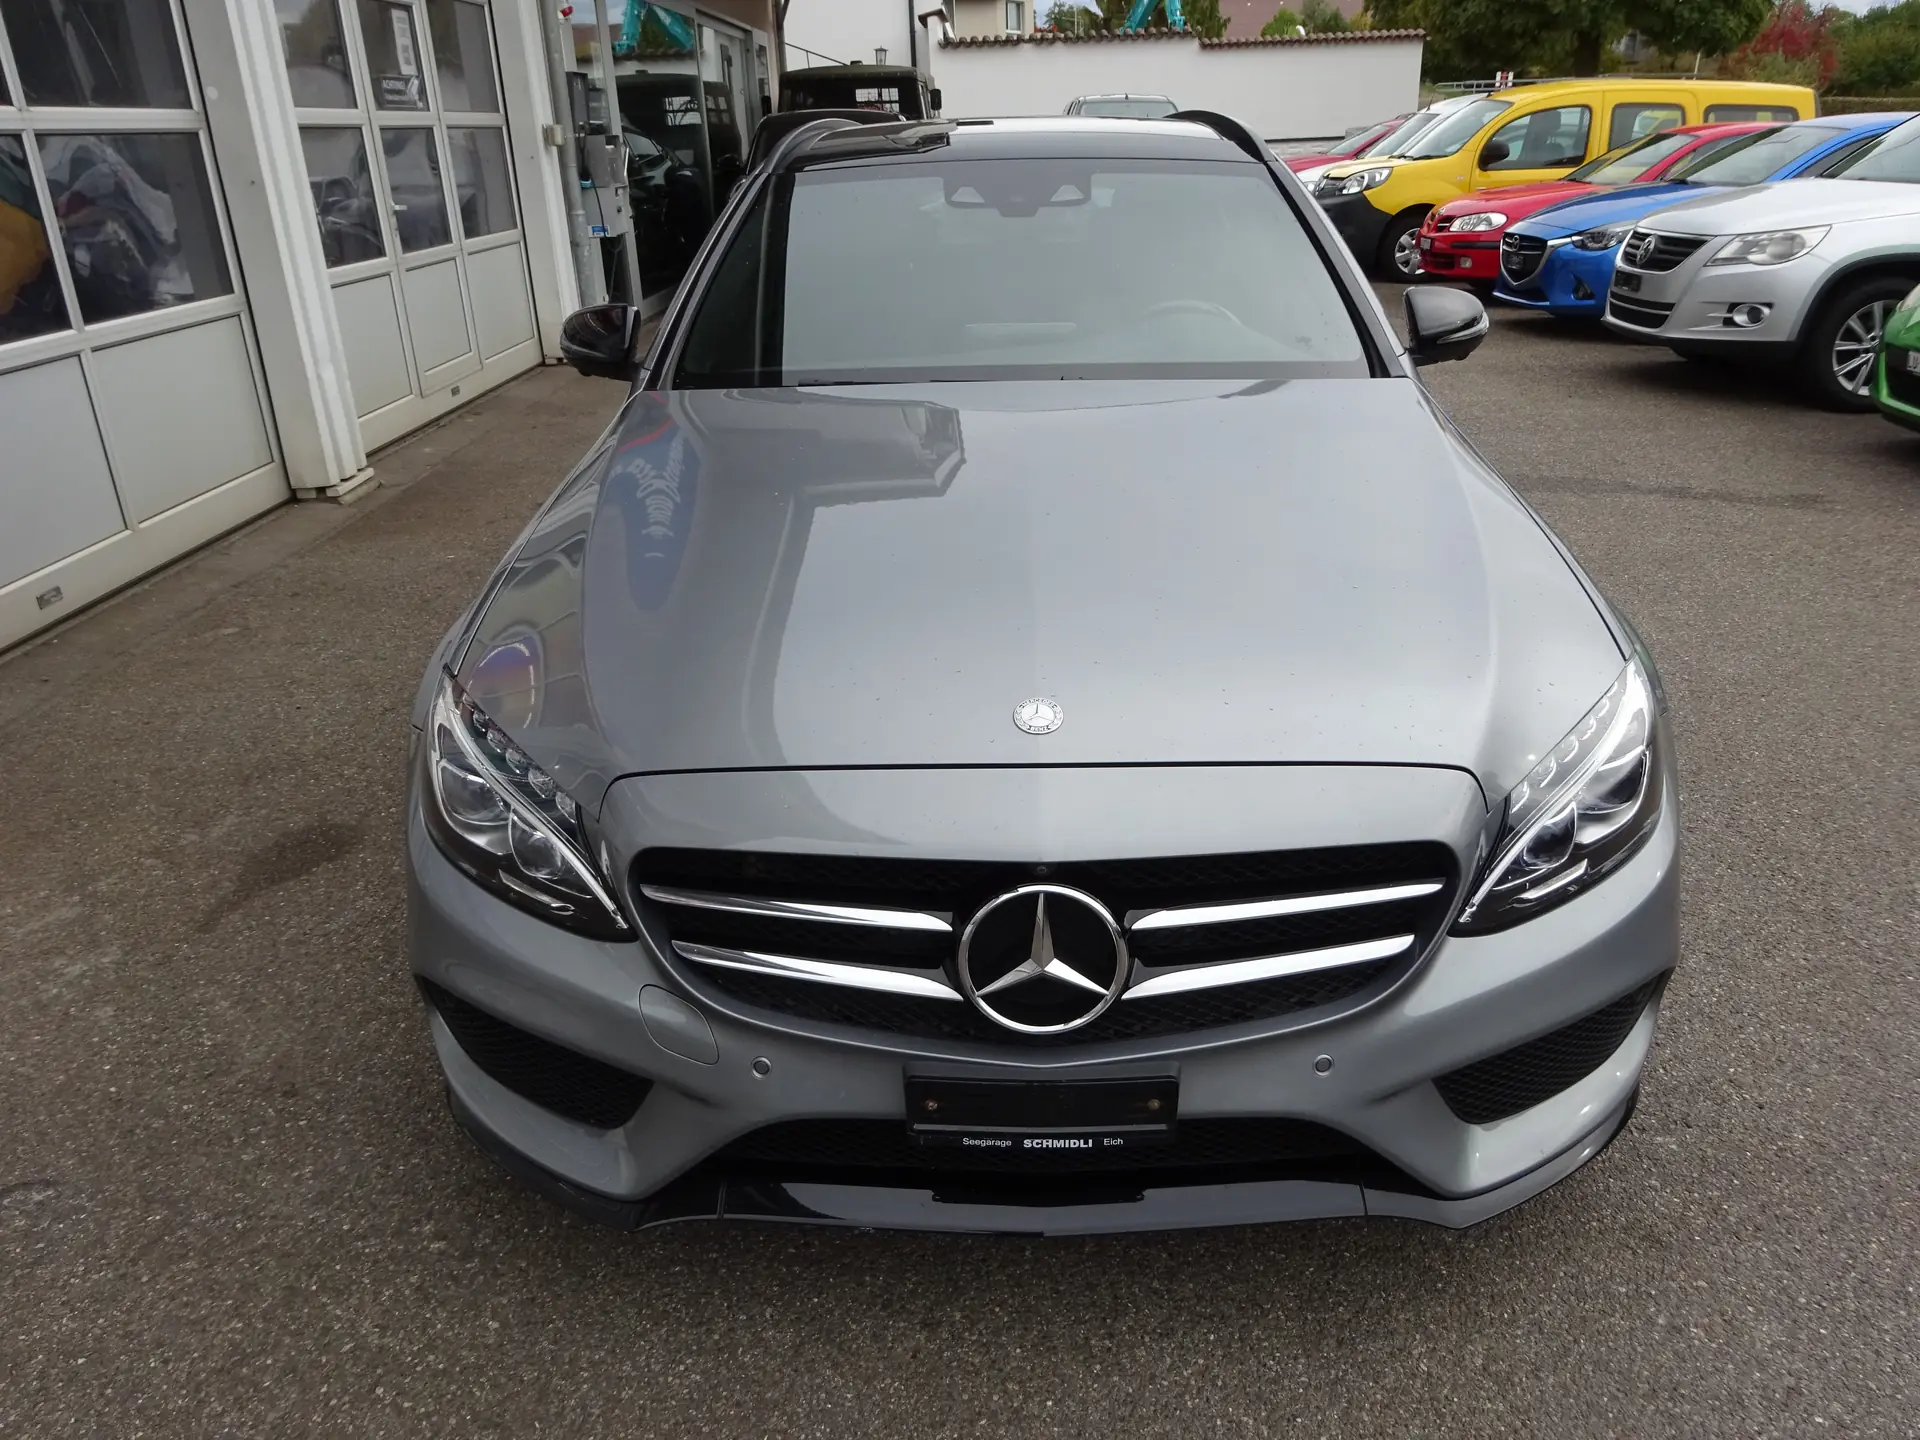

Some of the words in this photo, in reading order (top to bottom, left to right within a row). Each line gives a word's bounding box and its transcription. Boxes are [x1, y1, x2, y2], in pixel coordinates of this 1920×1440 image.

[962, 1137, 1012, 1148] Seegarage
[1023, 1139, 1093, 1148] SCHMIDLI
[1103, 1138, 1124, 1146] Eich
